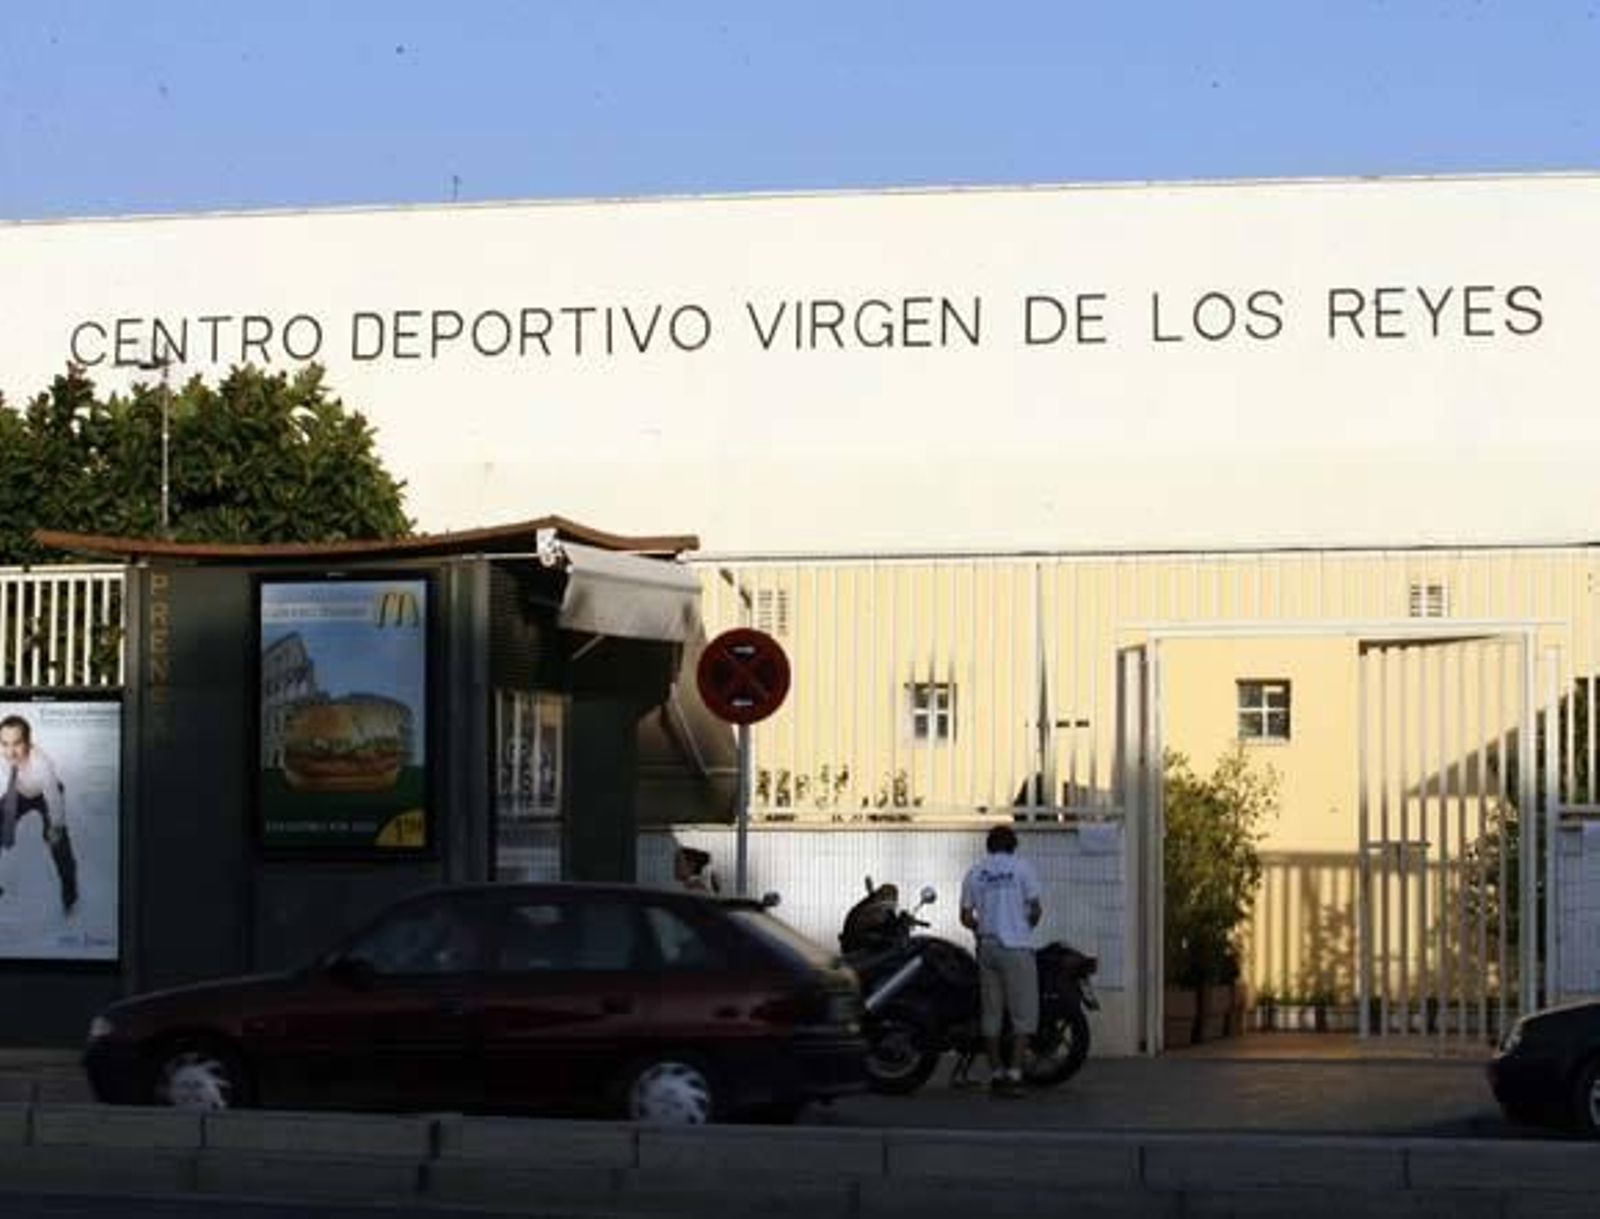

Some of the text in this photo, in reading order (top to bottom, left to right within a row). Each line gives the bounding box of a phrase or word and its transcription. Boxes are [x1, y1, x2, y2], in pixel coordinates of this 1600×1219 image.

[70, 285, 1543, 367] CENTRO DEPORTIVO VIRGEN DE LOS REYES
[150, 573, 169, 732] PREN
